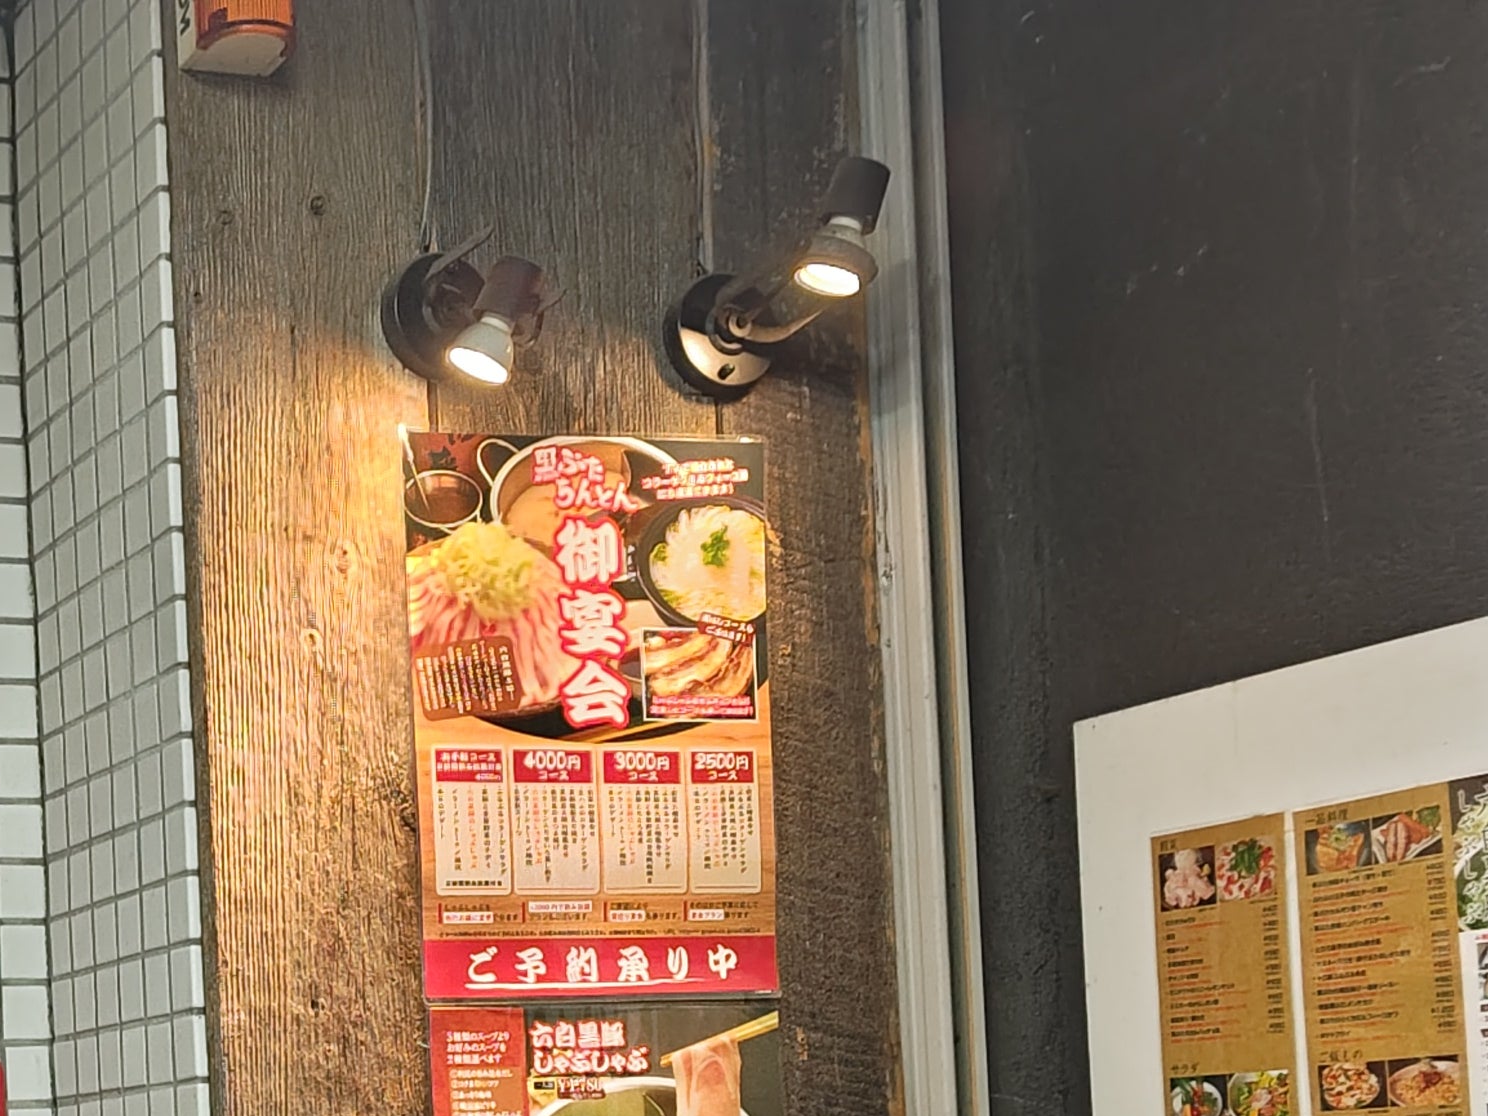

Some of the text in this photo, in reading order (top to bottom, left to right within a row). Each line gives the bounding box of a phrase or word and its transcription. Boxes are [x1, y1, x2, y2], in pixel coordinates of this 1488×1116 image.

[533, 446, 605, 483] 黒ぶた
[555, 520, 629, 727] 御宴会
[523, 751, 581, 770] 4000円
[614, 751, 670, 770] 3000円
[694, 752, 749, 770] 2500円
[538, 770, 570, 781] コース
[628, 771, 658, 781] コース
[708, 770, 738, 781] コース
[467, 944, 738, 984] ご予約承り中
[531, 1021, 625, 1048] 六白黒豚
[533, 1048, 649, 1073] しゃぶしゃぶ
